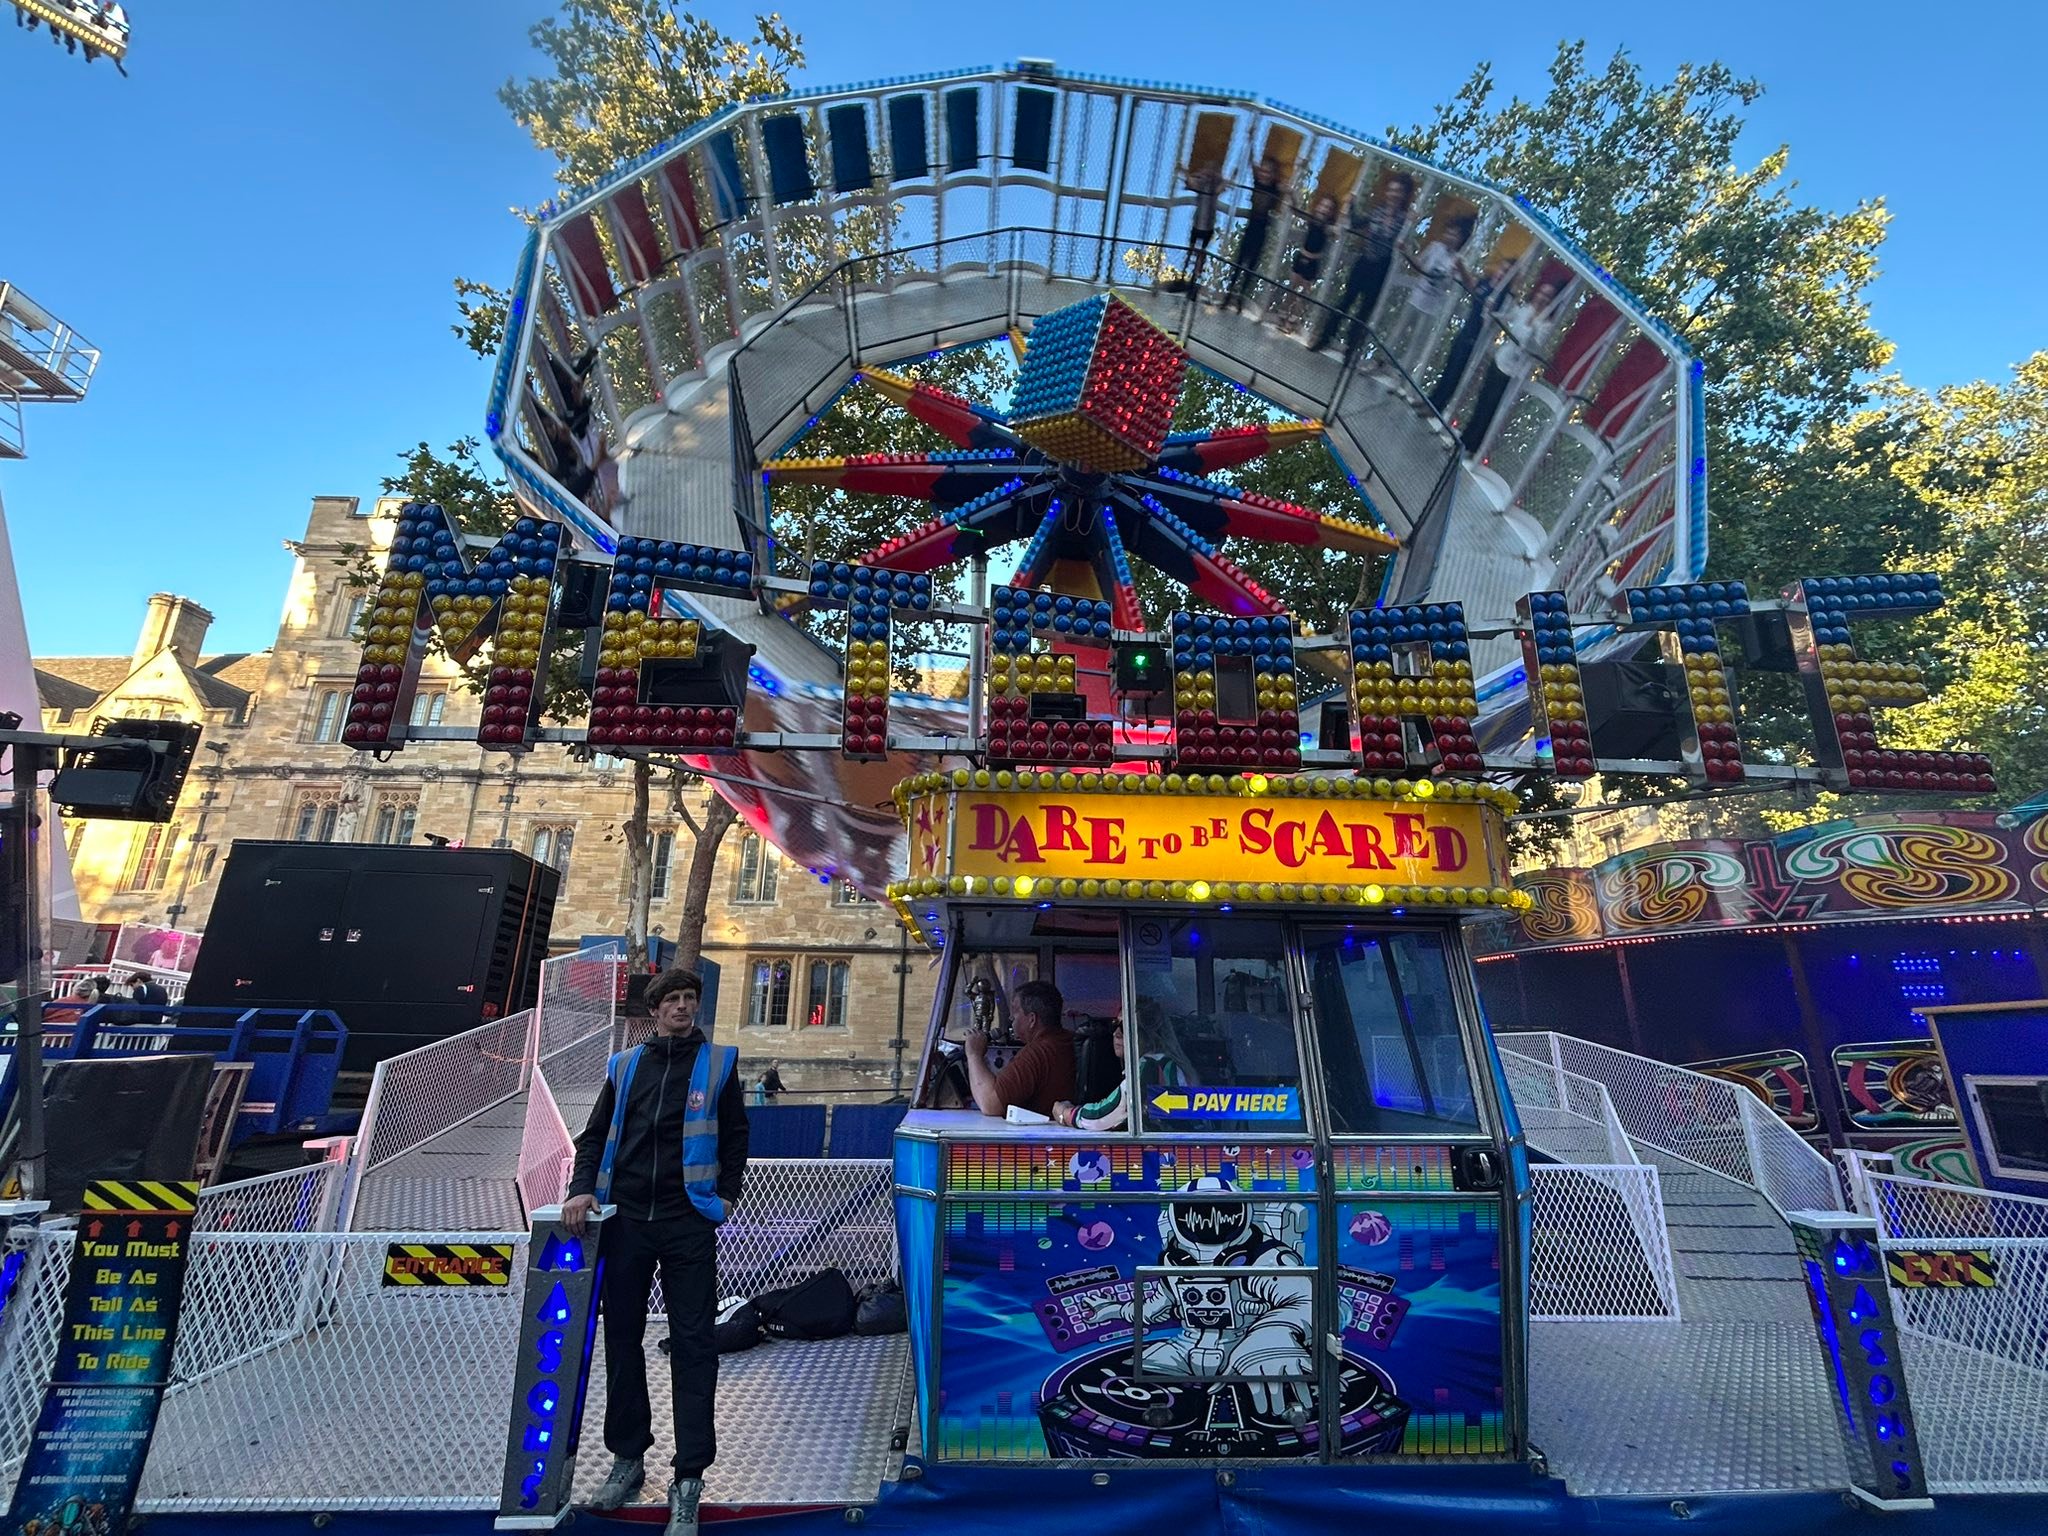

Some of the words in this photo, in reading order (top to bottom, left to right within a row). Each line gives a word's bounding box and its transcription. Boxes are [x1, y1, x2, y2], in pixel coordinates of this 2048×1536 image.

[343, 502, 1998, 793] METEORITE
[969, 803, 1125, 864] DARE
[1138, 837, 1181, 859] TO
[1190, 818, 1229, 847] BE
[1240, 808, 1468, 872] SCARED
[1193, 1093, 1232, 1112] PAY
[1235, 1094, 1288, 1112] HERE
[82, 1241, 119, 1256] You
[126, 1241, 179, 1257] Must
[391, 1257, 504, 1274] ENTRANCE
[1903, 1255, 1974, 1281] EXIT
[95, 1269, 122, 1284] Be
[128, 1269, 158, 1285] As
[89, 1296, 122, 1312] Tall
[128, 1297, 158, 1312] As
[72, 1324, 115, 1340] This
[122, 1325, 166, 1340] Line
[77, 1353, 99, 1369] To
[105, 1353, 150, 1369] Ride
